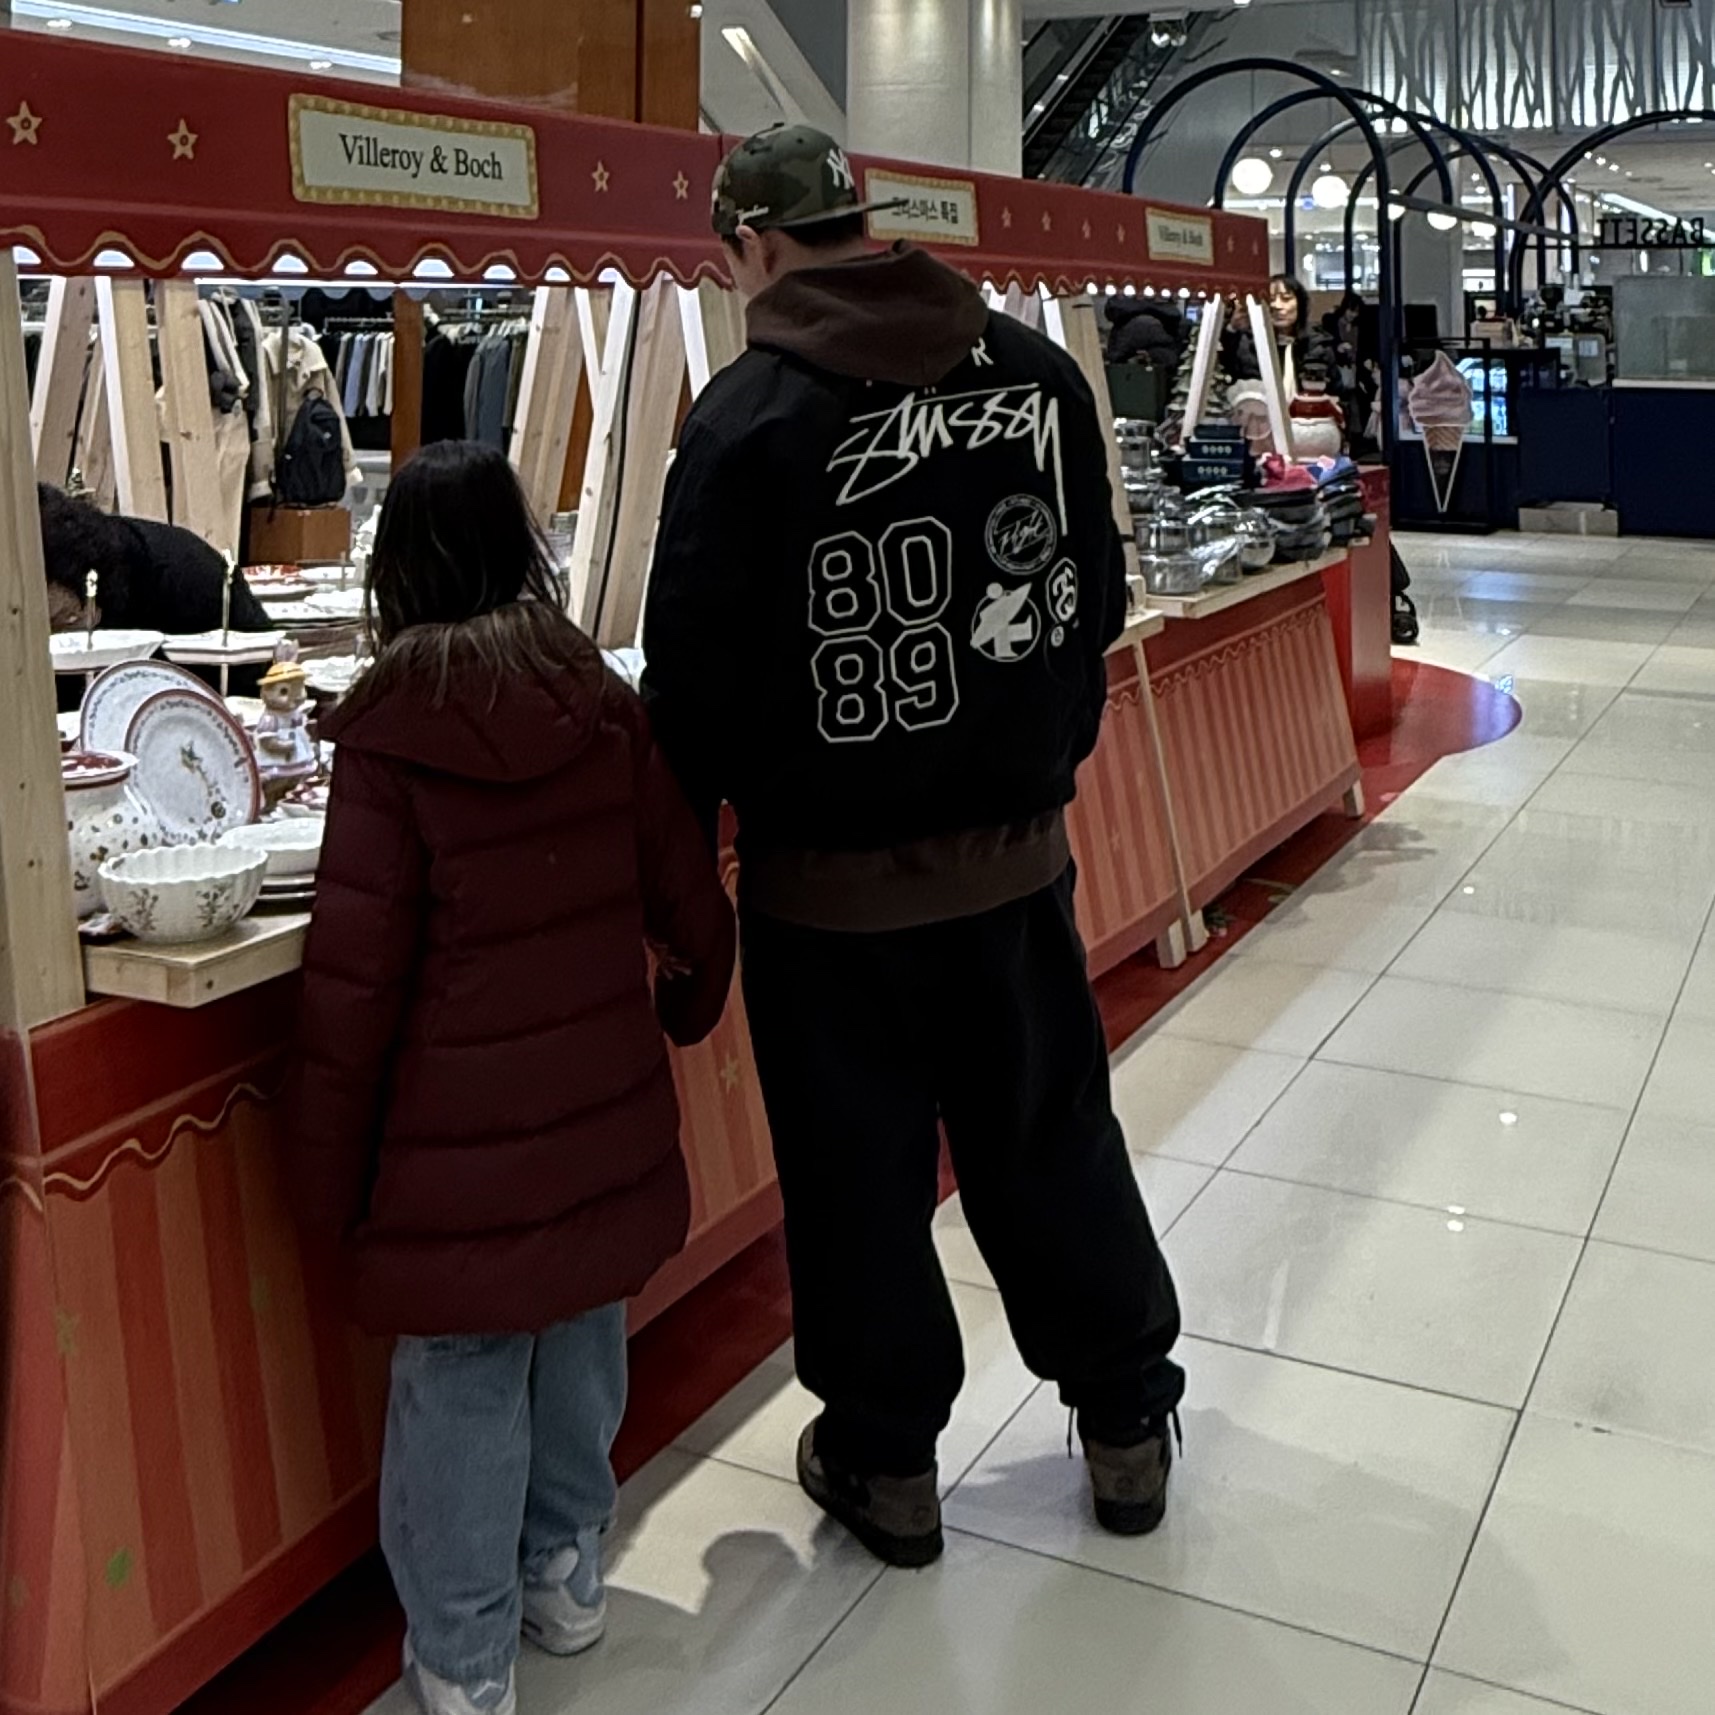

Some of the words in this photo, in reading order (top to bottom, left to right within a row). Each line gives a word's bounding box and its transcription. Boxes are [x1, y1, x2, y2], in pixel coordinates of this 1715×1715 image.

[339, 133, 424, 178] Villeroy
[430, 144, 448, 174] &
[453, 148, 503, 180] Boch
[807, 515, 952, 636] 80
[810, 621, 960, 743] 89
